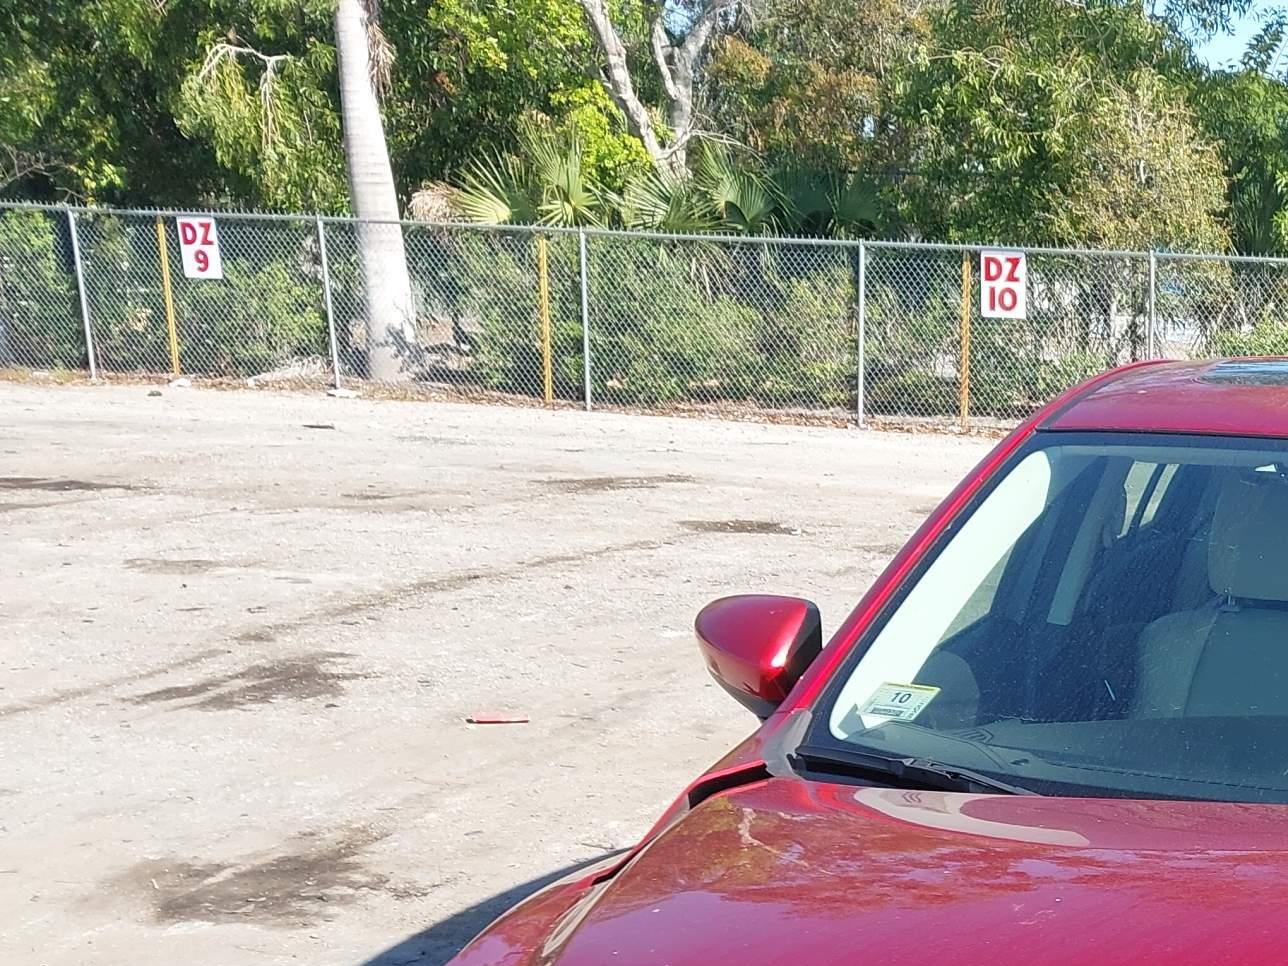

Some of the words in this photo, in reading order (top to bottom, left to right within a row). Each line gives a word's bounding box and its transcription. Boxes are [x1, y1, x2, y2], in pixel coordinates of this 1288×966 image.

[180, 222, 214, 245] DZ
[194, 249, 209, 272] 9
[984, 256, 1021, 282] DZ
[989, 286, 1017, 311] 10
[891, 692, 912, 703] 10
